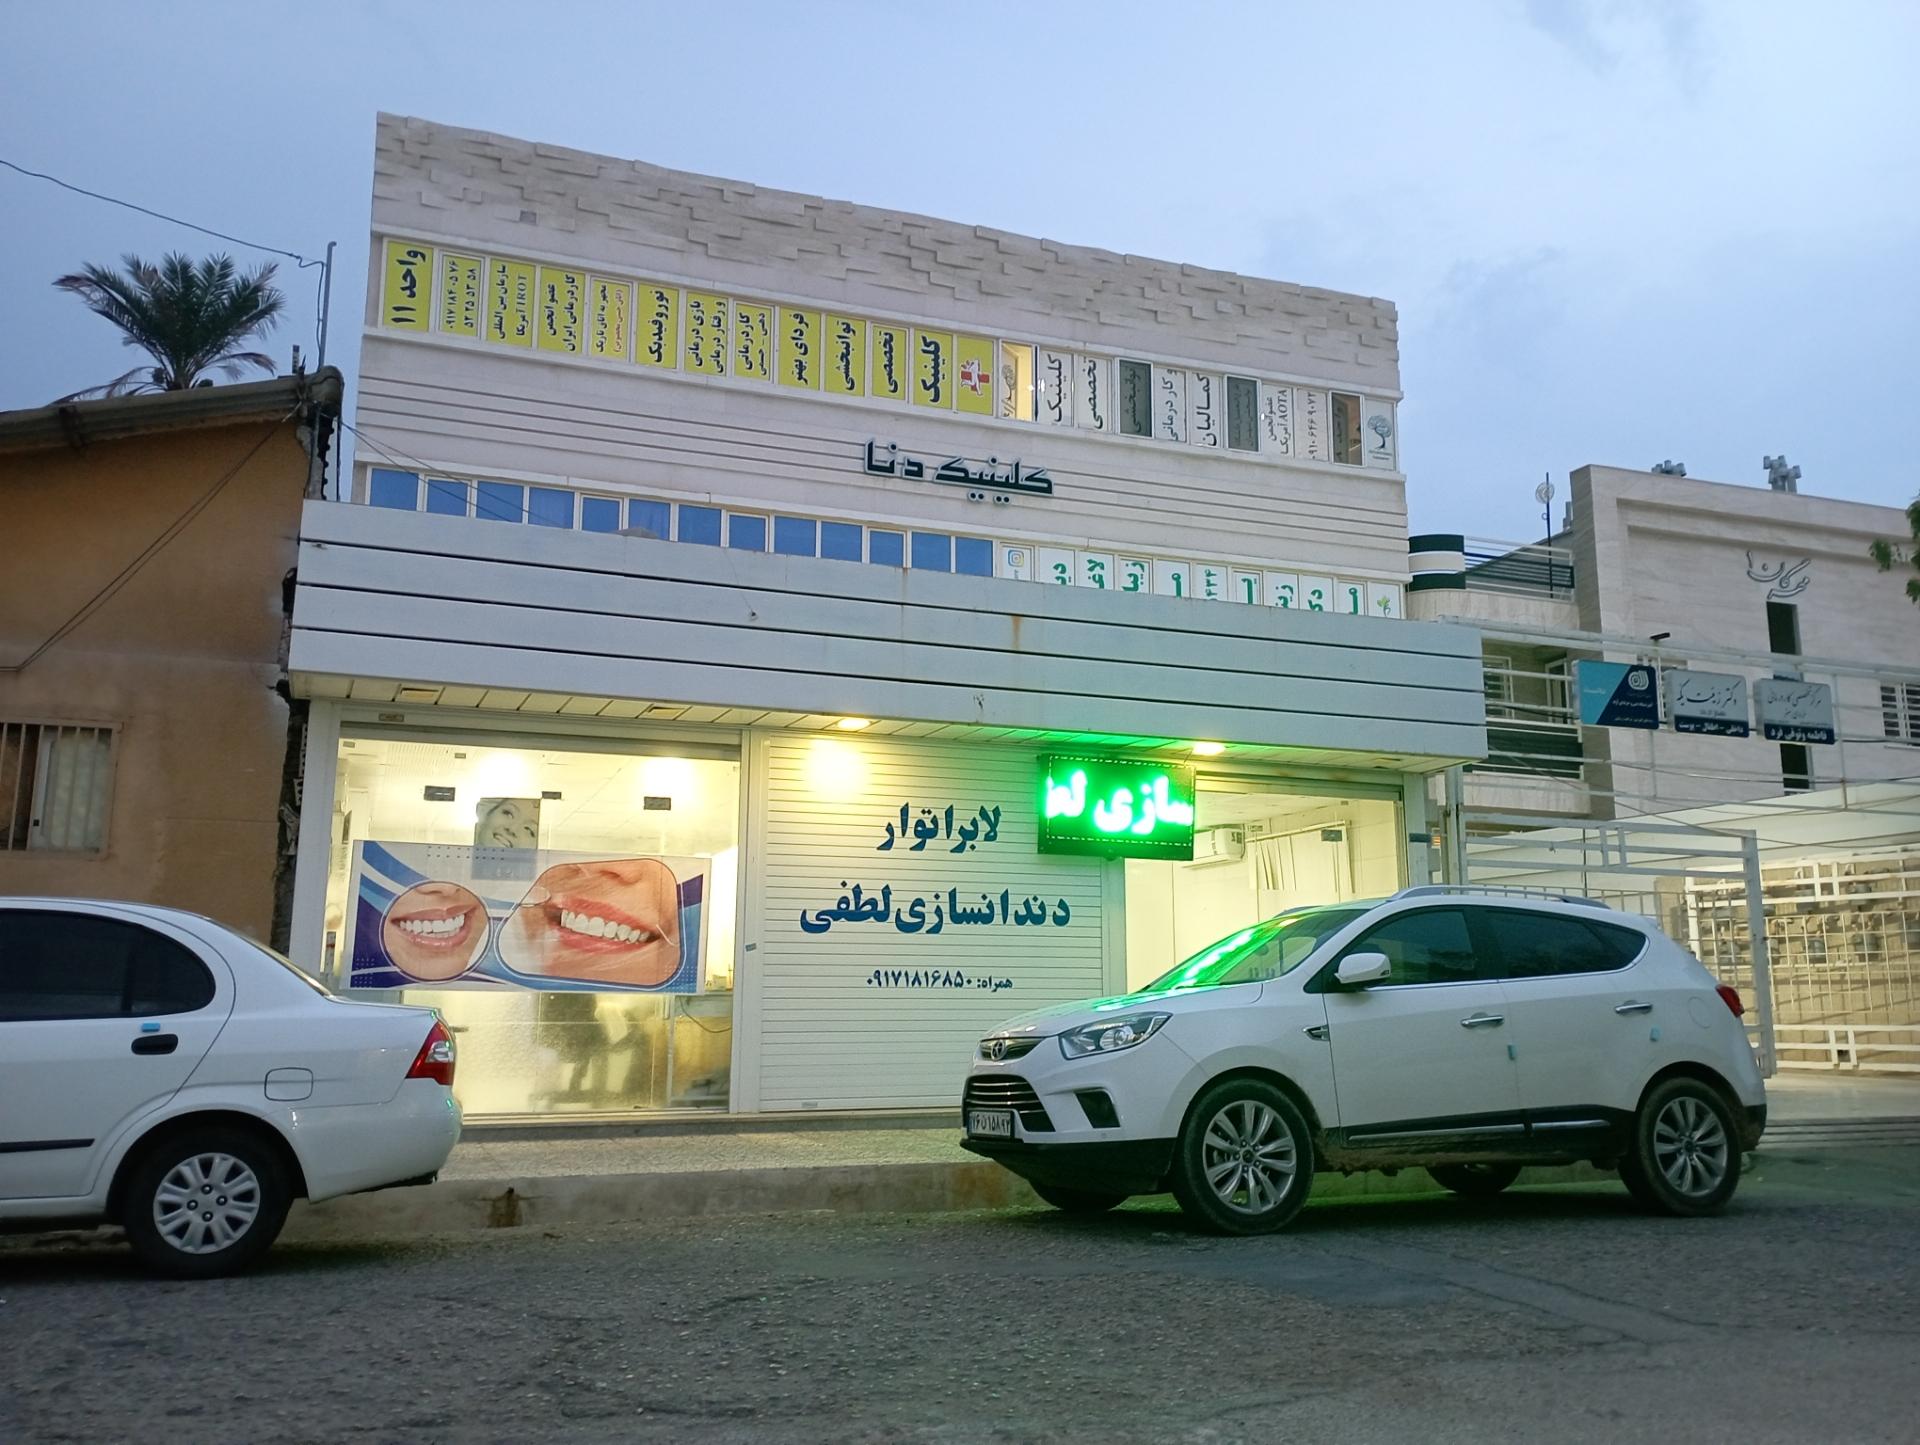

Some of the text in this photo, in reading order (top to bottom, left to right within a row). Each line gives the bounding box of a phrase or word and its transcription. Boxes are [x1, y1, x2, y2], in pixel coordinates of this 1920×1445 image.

[391, 250, 426, 323] واحد ۱۱
[493, 264, 508, 339] سازمان بین المللی
[544, 284, 558, 336] عضو انجمن
[446, 308, 457, 328] ۰۹۱۷
[563, 326, 576, 351] ایران
[596, 331, 607, 352] تاریک
[648, 290, 669, 363] نوروفیدبک
[688, 301, 704, 367] بازی درمانی
[711, 309, 725, 335] رفتار
[756, 313, 768, 336] ذهنی
[709, 337, 724, 373] درمانی
[790, 313, 809, 385] فردای بهتر
[836, 320, 856, 391] توانبخشی
[878, 330, 898, 393] تخصصی
[921, 335, 946, 403] کلینیک
[1047, 354, 1067, 422] کلینیک
[1082, 356, 1104, 429] تخصصی
[1196, 373, 1217, 447] کمالیان
[1265, 397, 1277, 441] عضو انجمن
[1277, 389, 1291, 455] AOTA آمریکا
[865, 439, 1053, 504] کلینیک دنا
[1086, 559, 1105, 589] لاغ
[1121, 560, 1145, 592] زیبا
[1721, 680, 1742, 708] دکتر
[1807, 730, 1828, 741] فاطمه
[876, 802, 1002, 853] لابراتوار
[799, 880, 893, 935] لطفی
[866, 969, 1013, 993] همراه: ۰۹۱۷۱۸۱۶۸۵۰
